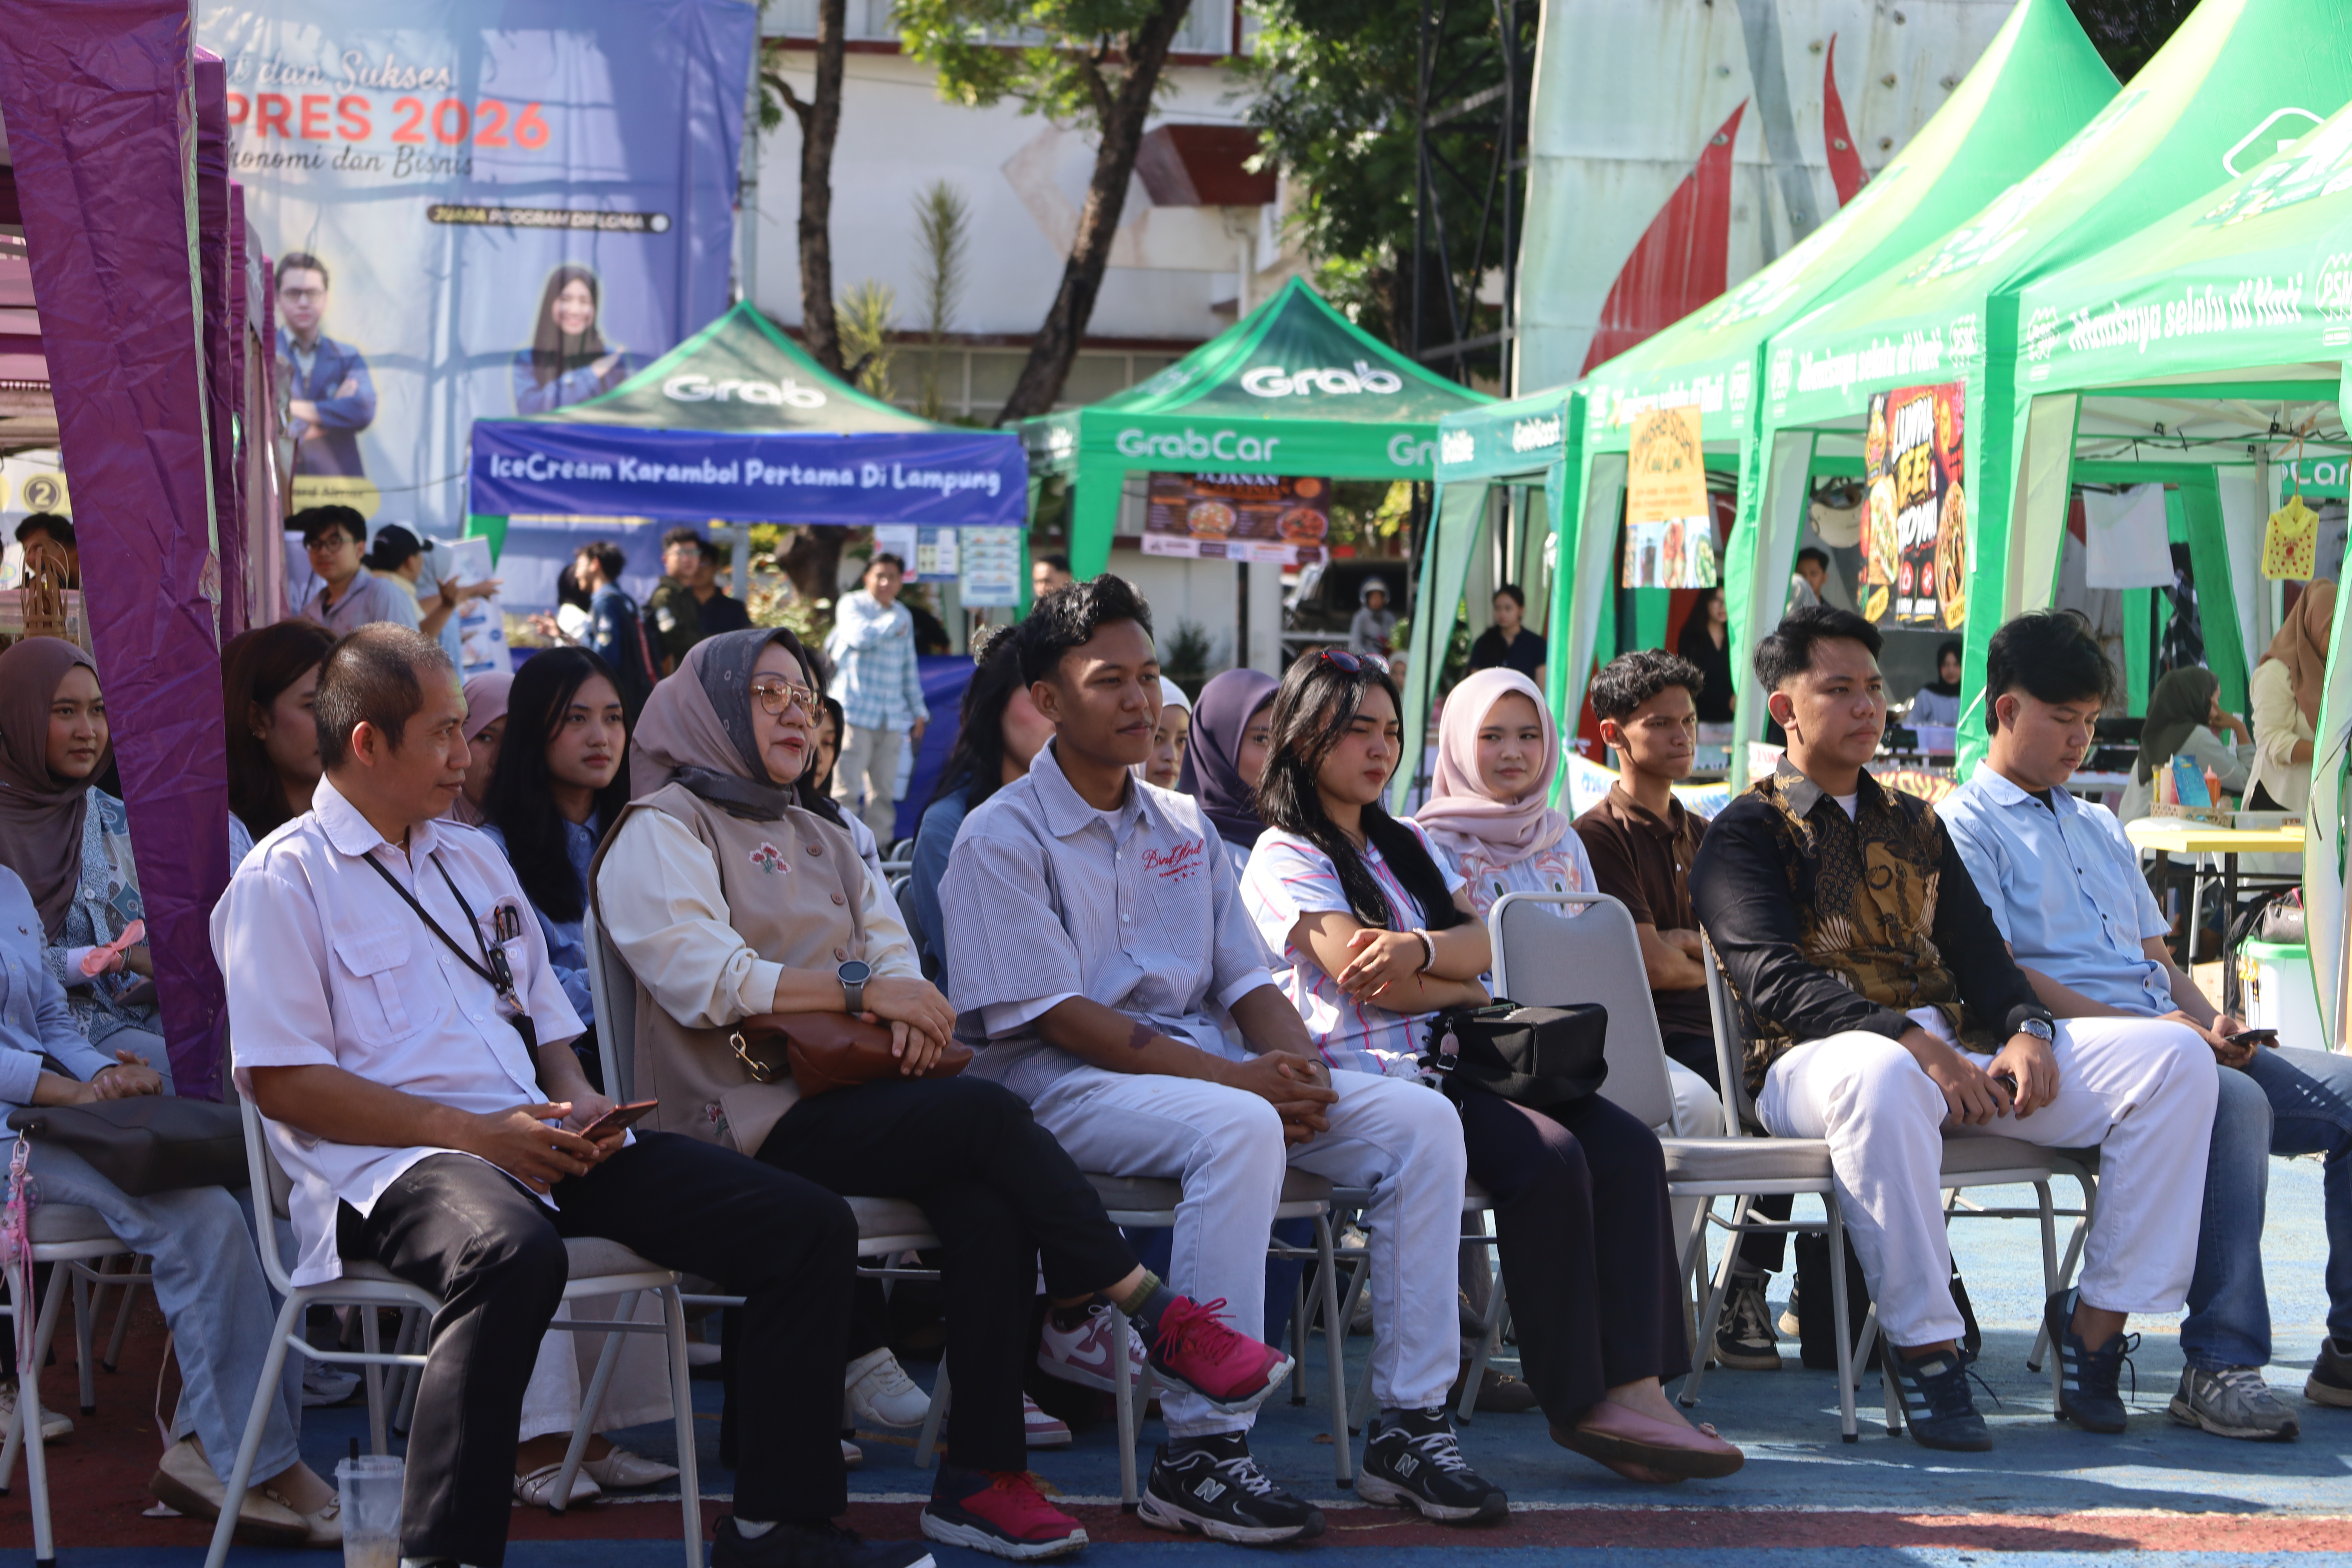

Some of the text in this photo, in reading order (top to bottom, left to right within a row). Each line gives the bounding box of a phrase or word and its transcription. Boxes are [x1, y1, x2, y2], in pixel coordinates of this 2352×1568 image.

[258, 51, 325, 86] dan
[335, 50, 450, 94] Sukses
[391, 96, 550, 148] 2026
[331, 145, 384, 171] dan
[392, 143, 473, 179] Bisnis
[433, 206, 644, 228] JUARA PROGRAM DIPLOMA
[2068, 272, 2303, 354] Manisnya selalu di Hati
[1857, 336, 1897, 382] selalu
[1897, 331, 1913, 375] di
[663, 374, 827, 409] Grab
[1241, 360, 1402, 398] Grab
[1116, 427, 1280, 462] GrabCar
[490, 452, 1001, 497] IceCream Karambol Pertama Di Lampung
[1898, 441, 1930, 510] BEEF
[34, 482, 51, 505] 2
[1394, 1452, 1419, 1479] N
[1193, 1477, 1227, 1503] N
